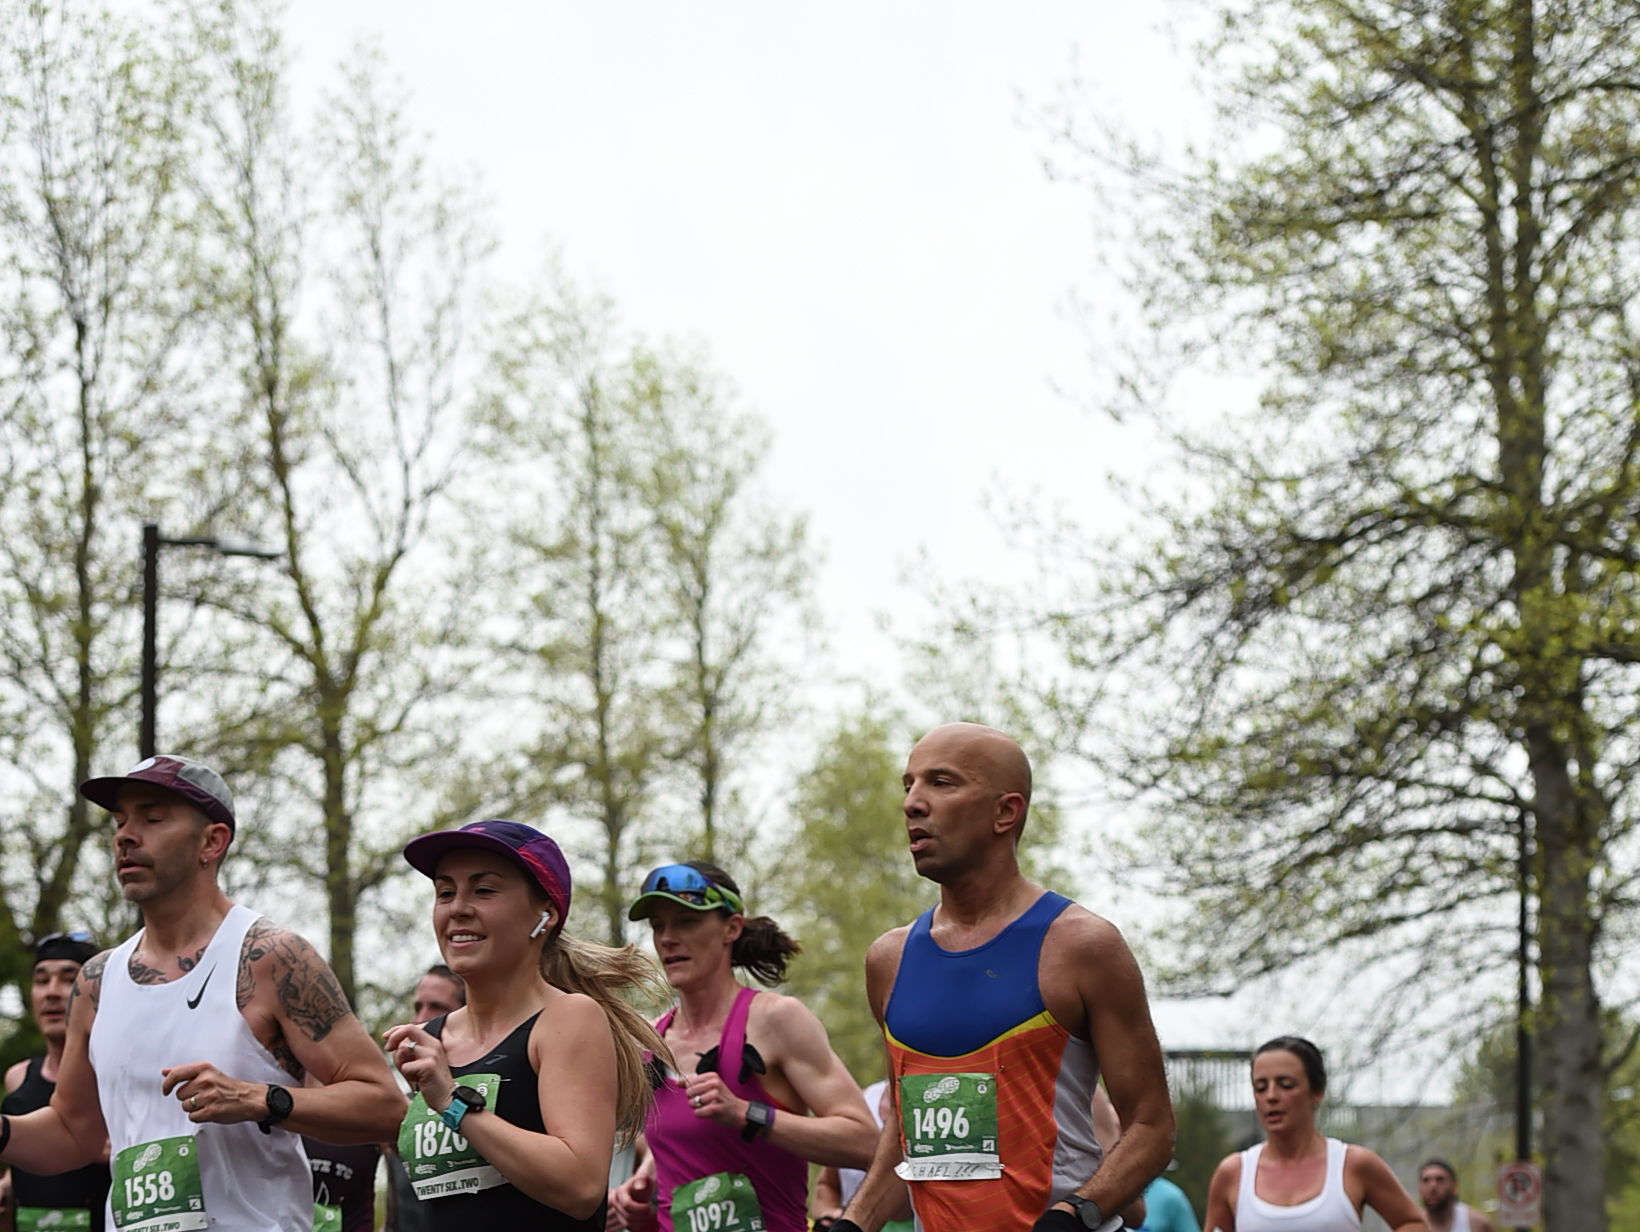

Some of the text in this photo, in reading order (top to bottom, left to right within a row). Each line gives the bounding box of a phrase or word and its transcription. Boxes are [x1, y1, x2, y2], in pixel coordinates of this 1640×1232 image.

[913, 1107, 970, 1140] 1496
[124, 1170, 175, 1208] 1558
[416, 1183, 445, 1196] TWENTY
